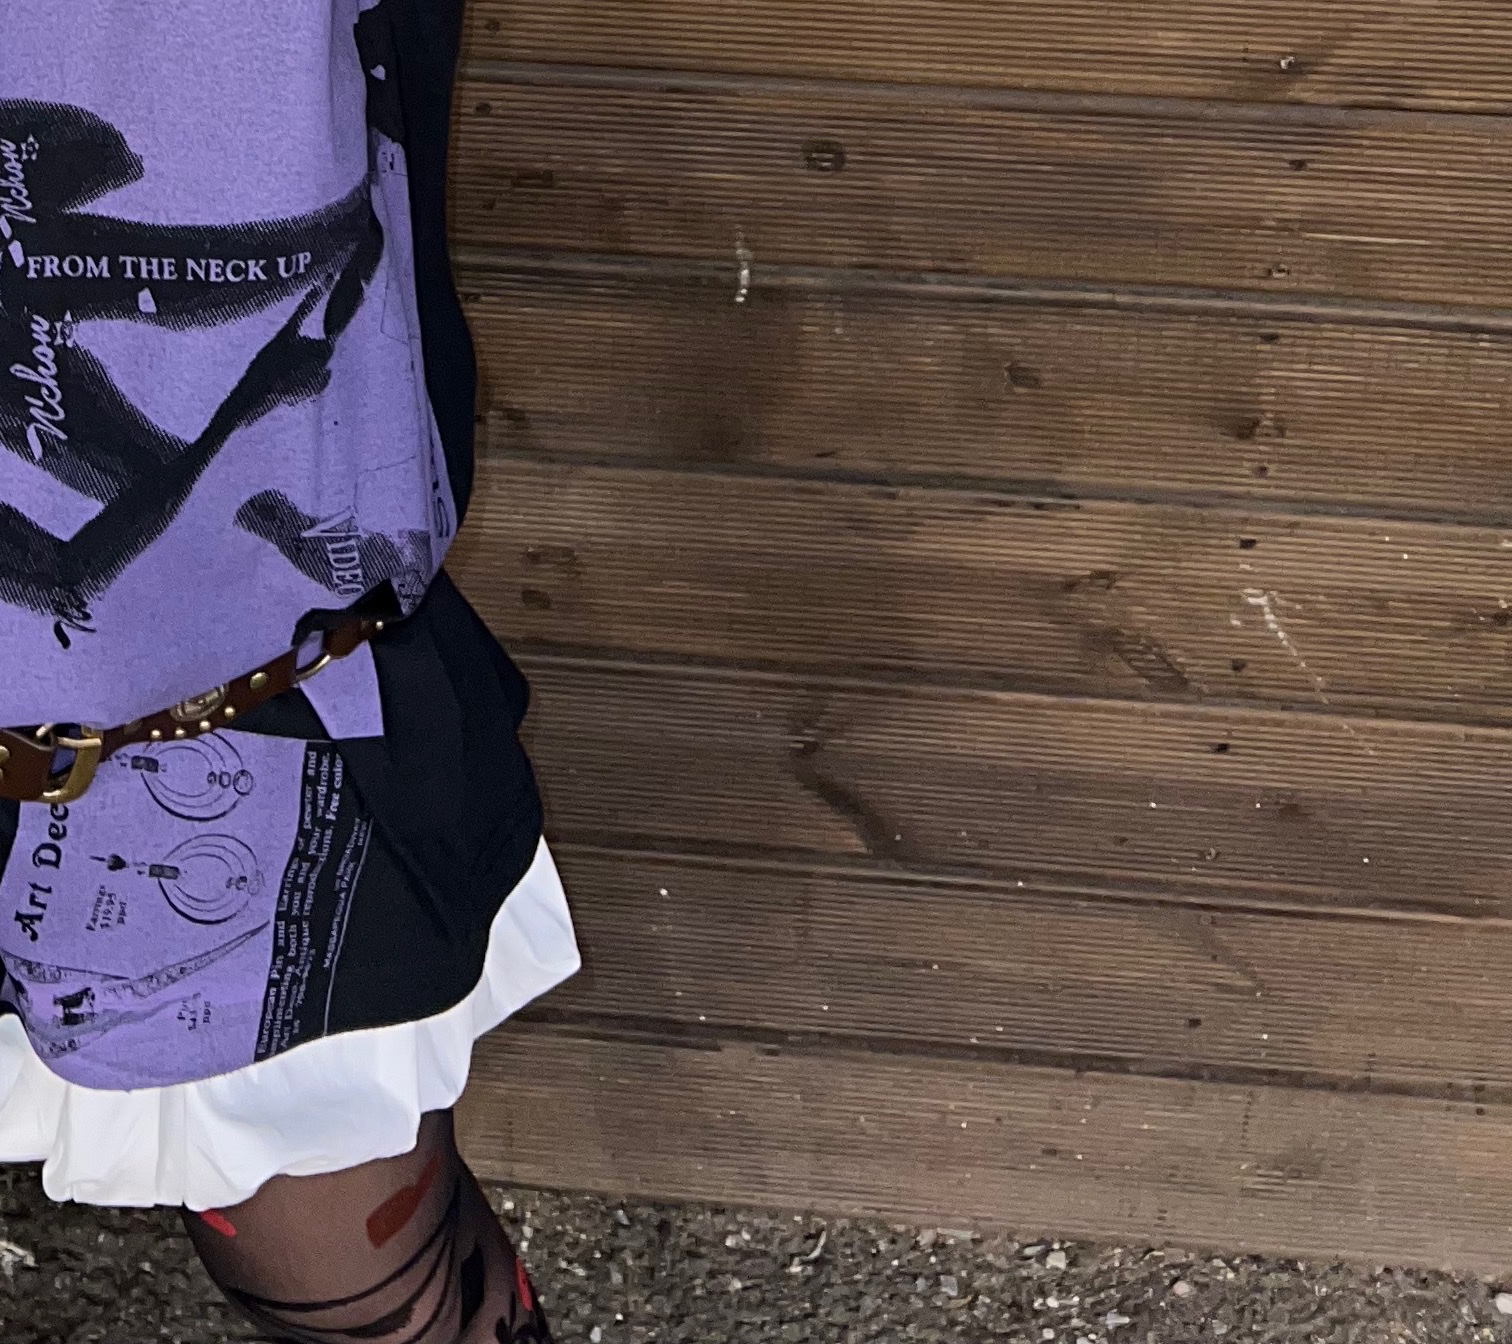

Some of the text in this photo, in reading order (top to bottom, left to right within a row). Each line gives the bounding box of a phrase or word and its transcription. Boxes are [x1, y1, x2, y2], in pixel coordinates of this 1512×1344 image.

[26, 251, 313, 283] FROM THE NECK UP
[307, 751, 316, 776] and
[325, 793, 340, 820] Free
[14, 806, 69, 942] Art Dec
